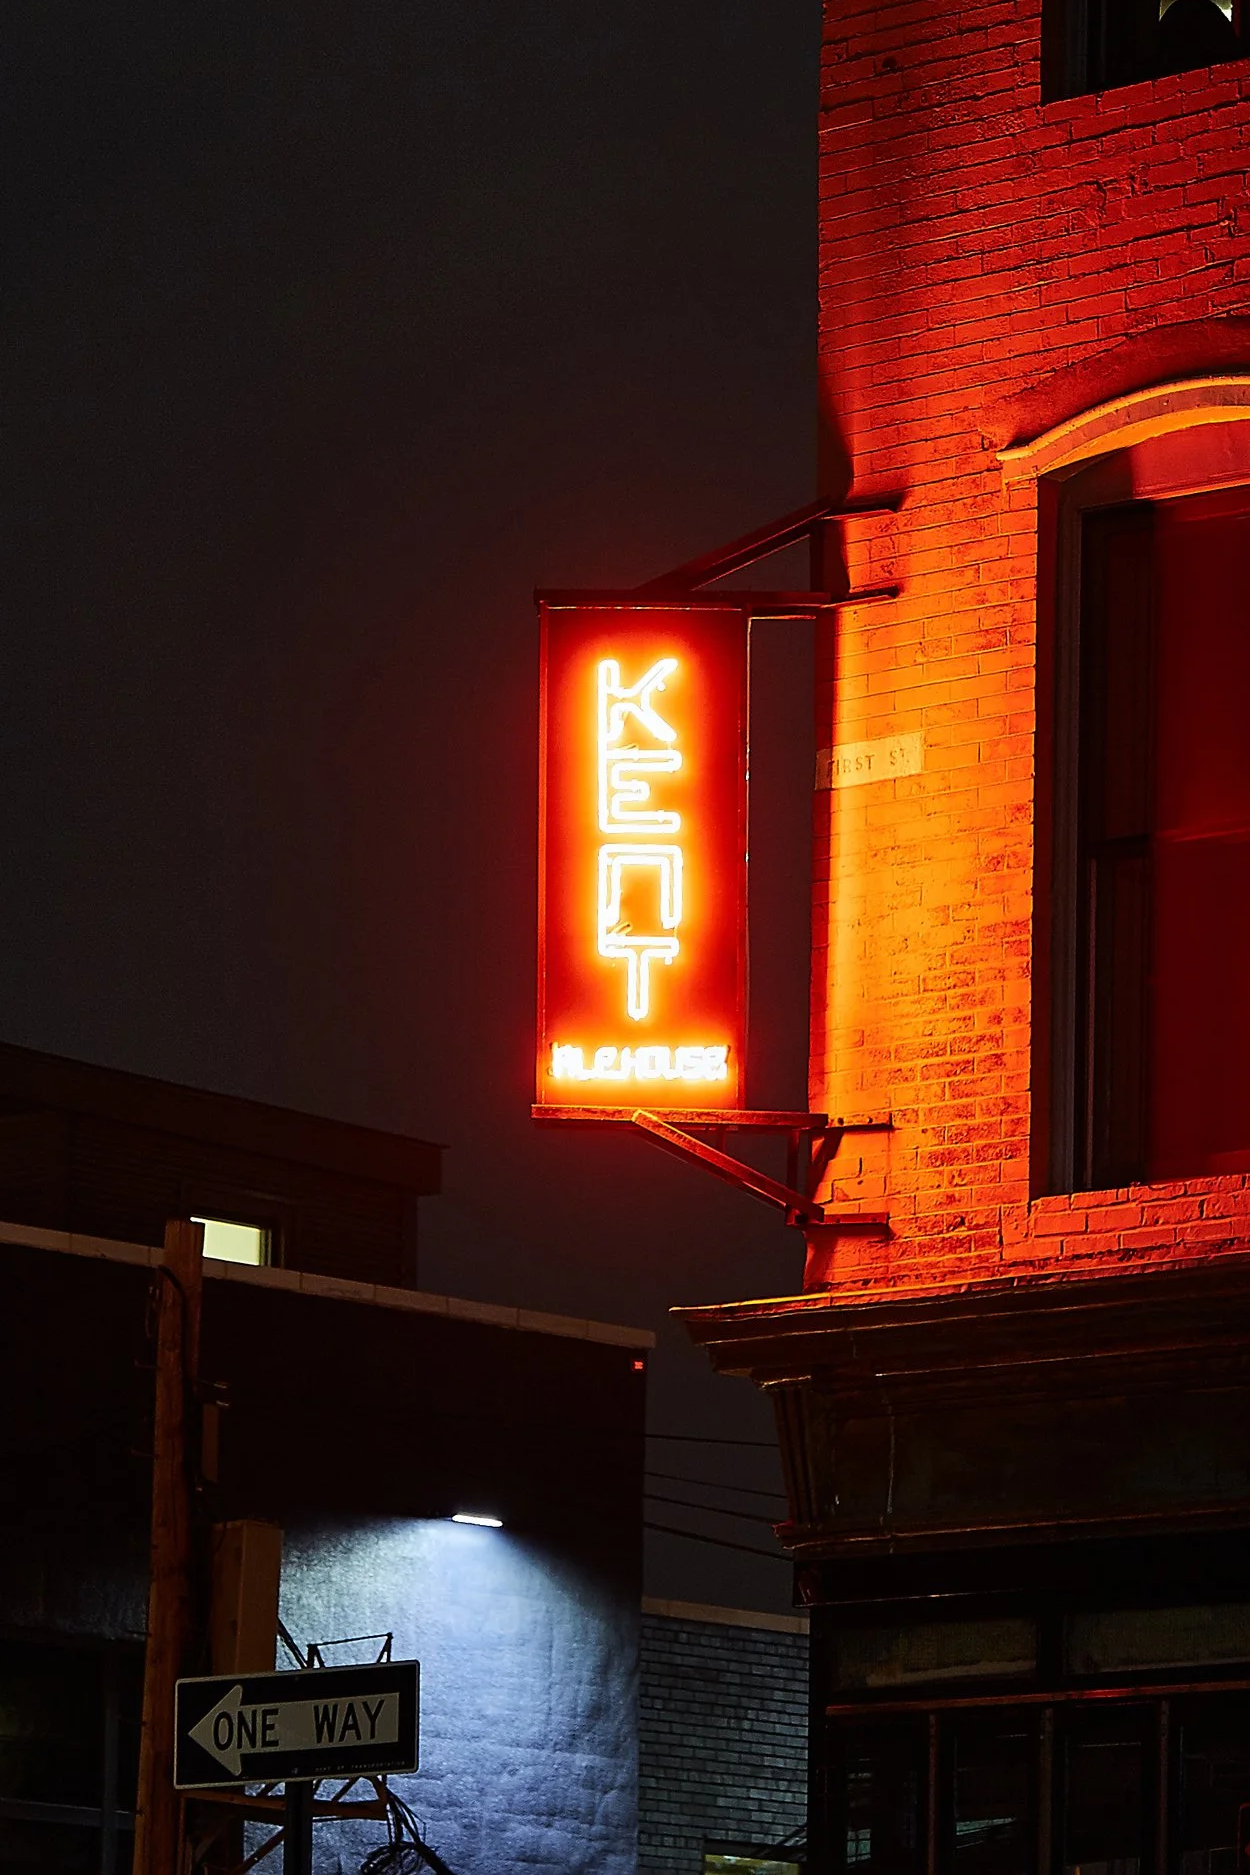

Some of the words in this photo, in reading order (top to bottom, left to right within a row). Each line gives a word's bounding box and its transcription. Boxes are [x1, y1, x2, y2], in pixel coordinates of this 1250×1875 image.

[597, 658, 683, 1021] KENT
[212, 1708, 279, 1751] ONE
[313, 1699, 386, 1744] WAY
